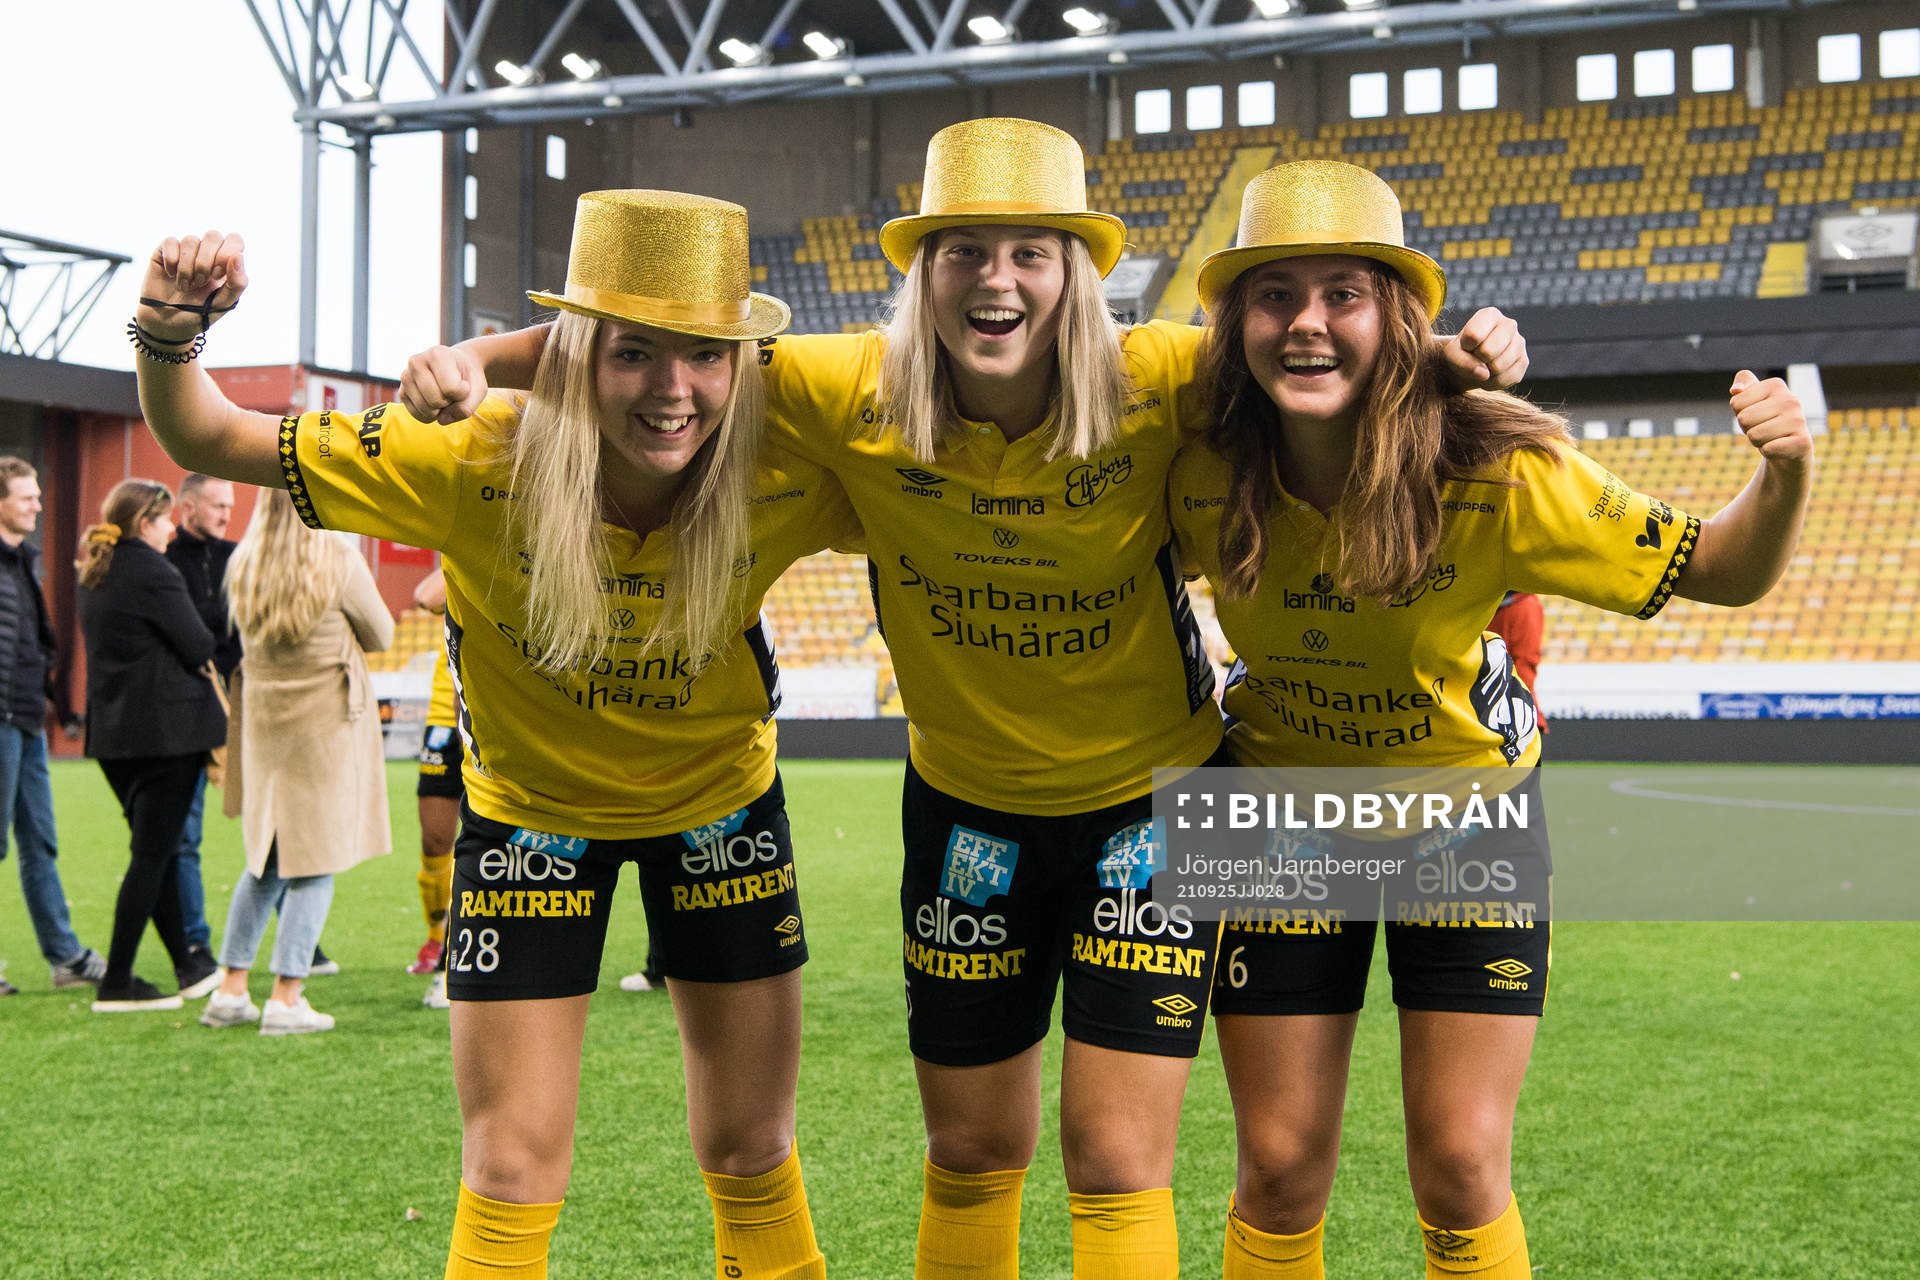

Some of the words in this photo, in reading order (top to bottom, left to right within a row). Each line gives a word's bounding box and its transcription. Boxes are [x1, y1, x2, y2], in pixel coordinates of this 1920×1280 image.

[901, 484, 943, 499] umbro
[1065, 454, 1133, 508] Elfsborg
[971, 493, 1044, 516] lamina
[953, 552, 1032, 567] TOVEKS
[1035, 558, 1060, 568] BIL
[899, 554, 1136, 613] Sparbanken
[1283, 589, 1355, 614] lamina
[930, 604, 1111, 658] Sjuhärad
[1265, 655, 1342, 667] TOVEKS
[1345, 661, 1369, 669] BIL
[1245, 674, 1445, 713] parbanken
[1258, 690, 1432, 748] Sjuhärad
[479, 843, 577, 881] ellos
[681, 830, 778, 875] ellos
[953, 831, 1008, 863] EFF
[672, 862, 795, 912] RAMIRENT
[946, 872, 976, 898] IV
[949, 850, 1008, 887] EKT
[1415, 850, 1517, 894] ellos
[459, 890, 595, 918] RAMIRENT
[916, 897, 1007, 946] ellos
[1093, 888, 1194, 940] ellos
[1397, 902, 1536, 929] RAMIRENT
[456, 928, 499, 973] 28
[779, 933, 801, 949] umbro
[904, 932, 1025, 981] RAMIRENT
[1072, 933, 1206, 979] RAMIRENT
[1489, 978, 1529, 991] umbro
[1156, 1014, 1192, 1028] umbro
